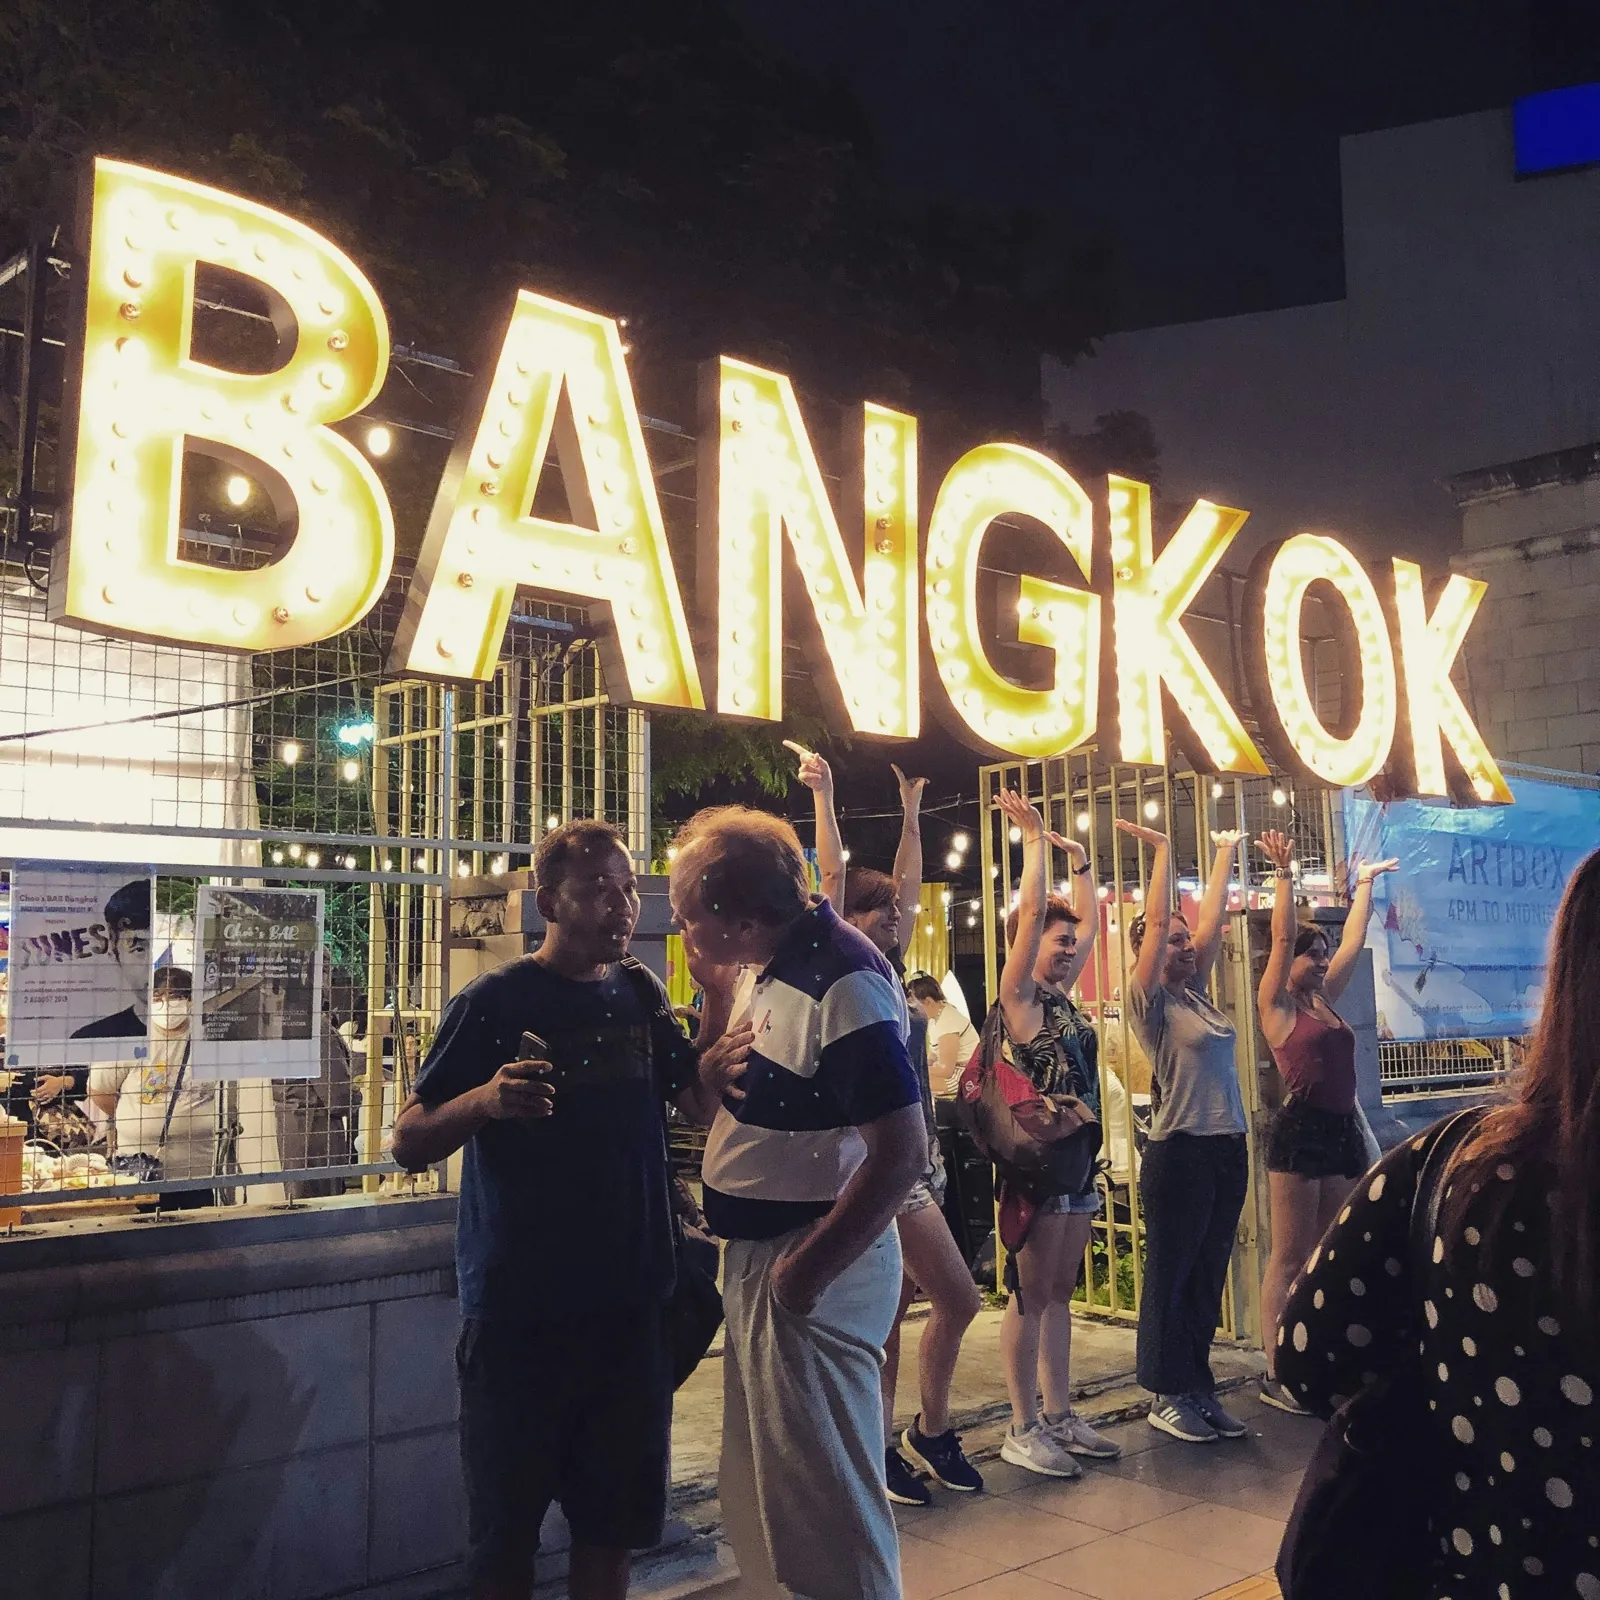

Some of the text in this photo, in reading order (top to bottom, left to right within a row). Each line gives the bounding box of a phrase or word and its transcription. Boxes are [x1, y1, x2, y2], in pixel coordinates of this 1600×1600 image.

[48, 156, 1515, 805] BANGKOK
[1447, 838, 1565, 891] ARTBOX
[64, 895, 99, 904] Bangkok
[1447, 899, 1477, 921] 4PM
[1482, 900, 1500, 921] TO
[268, 924, 301, 941] BAR
